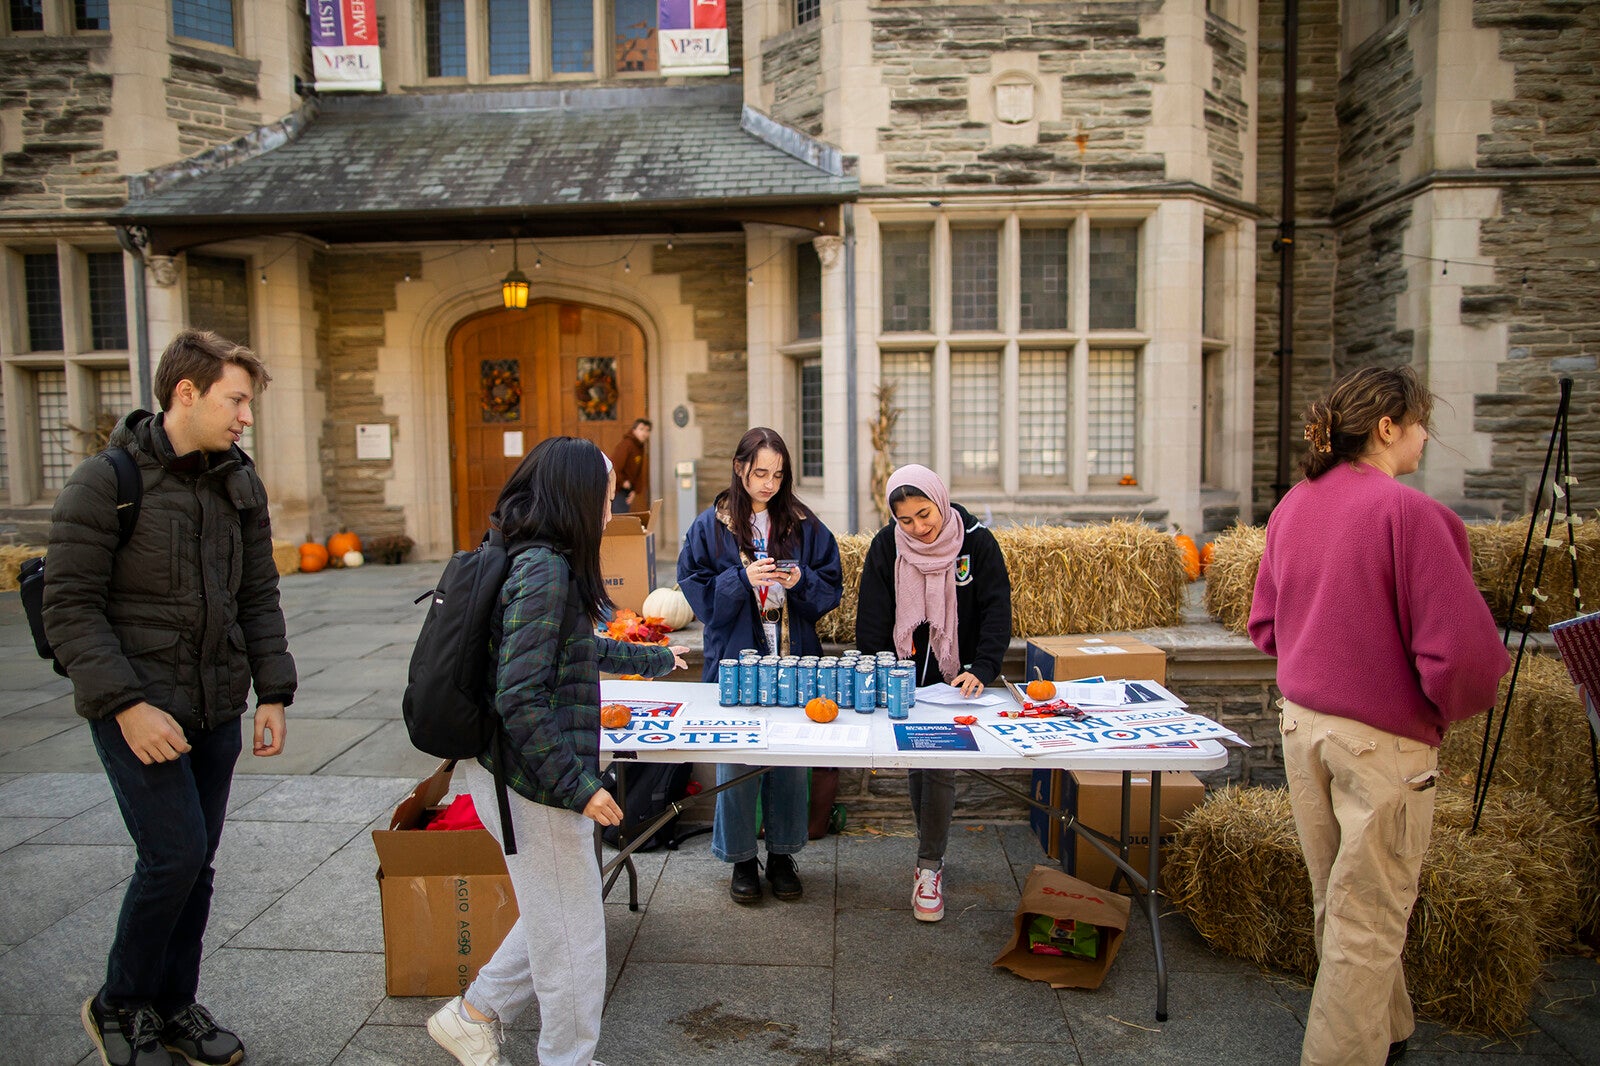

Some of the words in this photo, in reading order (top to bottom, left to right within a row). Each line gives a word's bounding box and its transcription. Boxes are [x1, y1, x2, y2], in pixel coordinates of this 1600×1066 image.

[987, 717, 1113, 735] PENN
[1112, 710, 1184, 721] LEADS
[1066, 723, 1201, 743] VOTE
[604, 732, 738, 744] VOTE
[457, 878, 469, 913] AGIO
